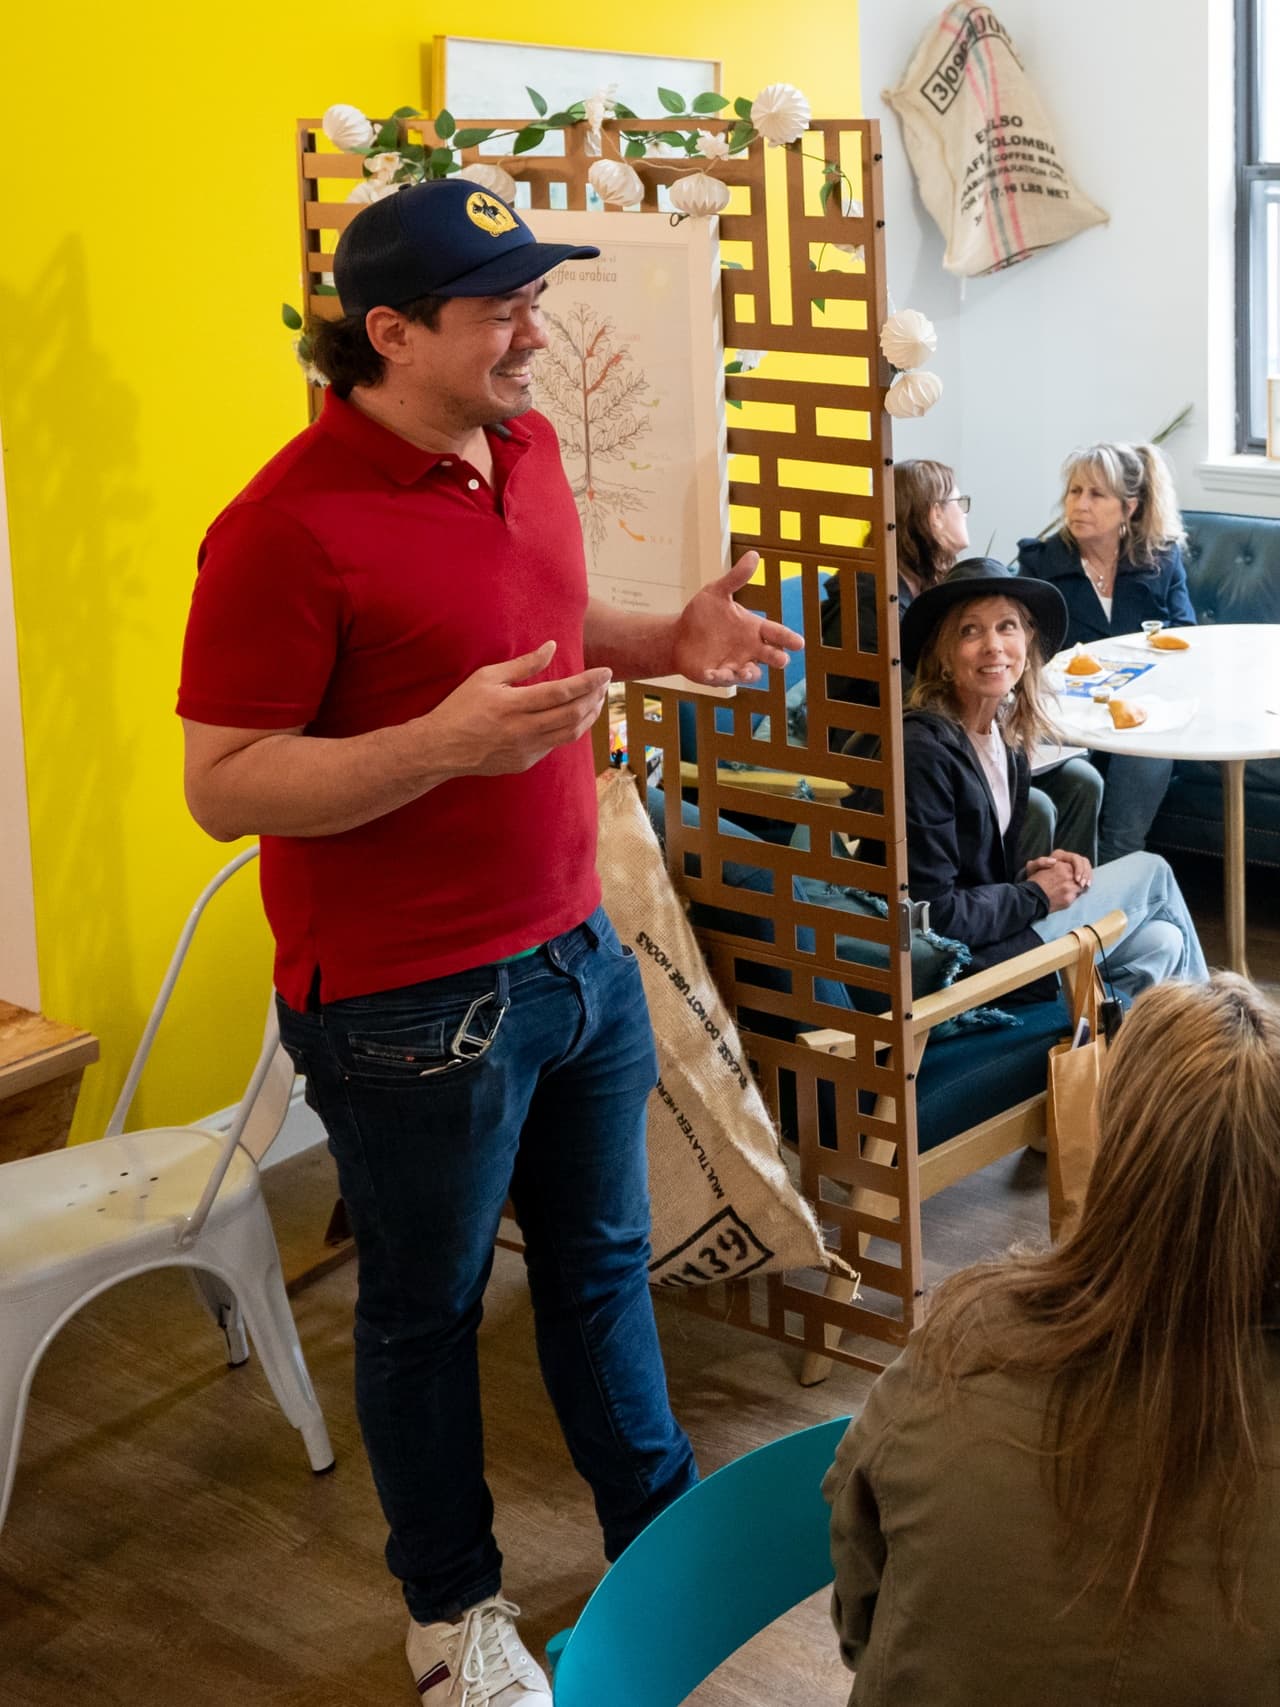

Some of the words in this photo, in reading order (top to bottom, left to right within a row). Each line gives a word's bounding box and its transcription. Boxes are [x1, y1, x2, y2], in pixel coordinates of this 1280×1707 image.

[578, 265, 617, 283] arabica
[635, 931, 673, 972] HOOKS
[668, 968, 691, 997] USE
[687, 994, 708, 1022] NOT
[704, 1020, 720, 1041] DO
[675, 1112, 726, 1200] MULTILAYER
